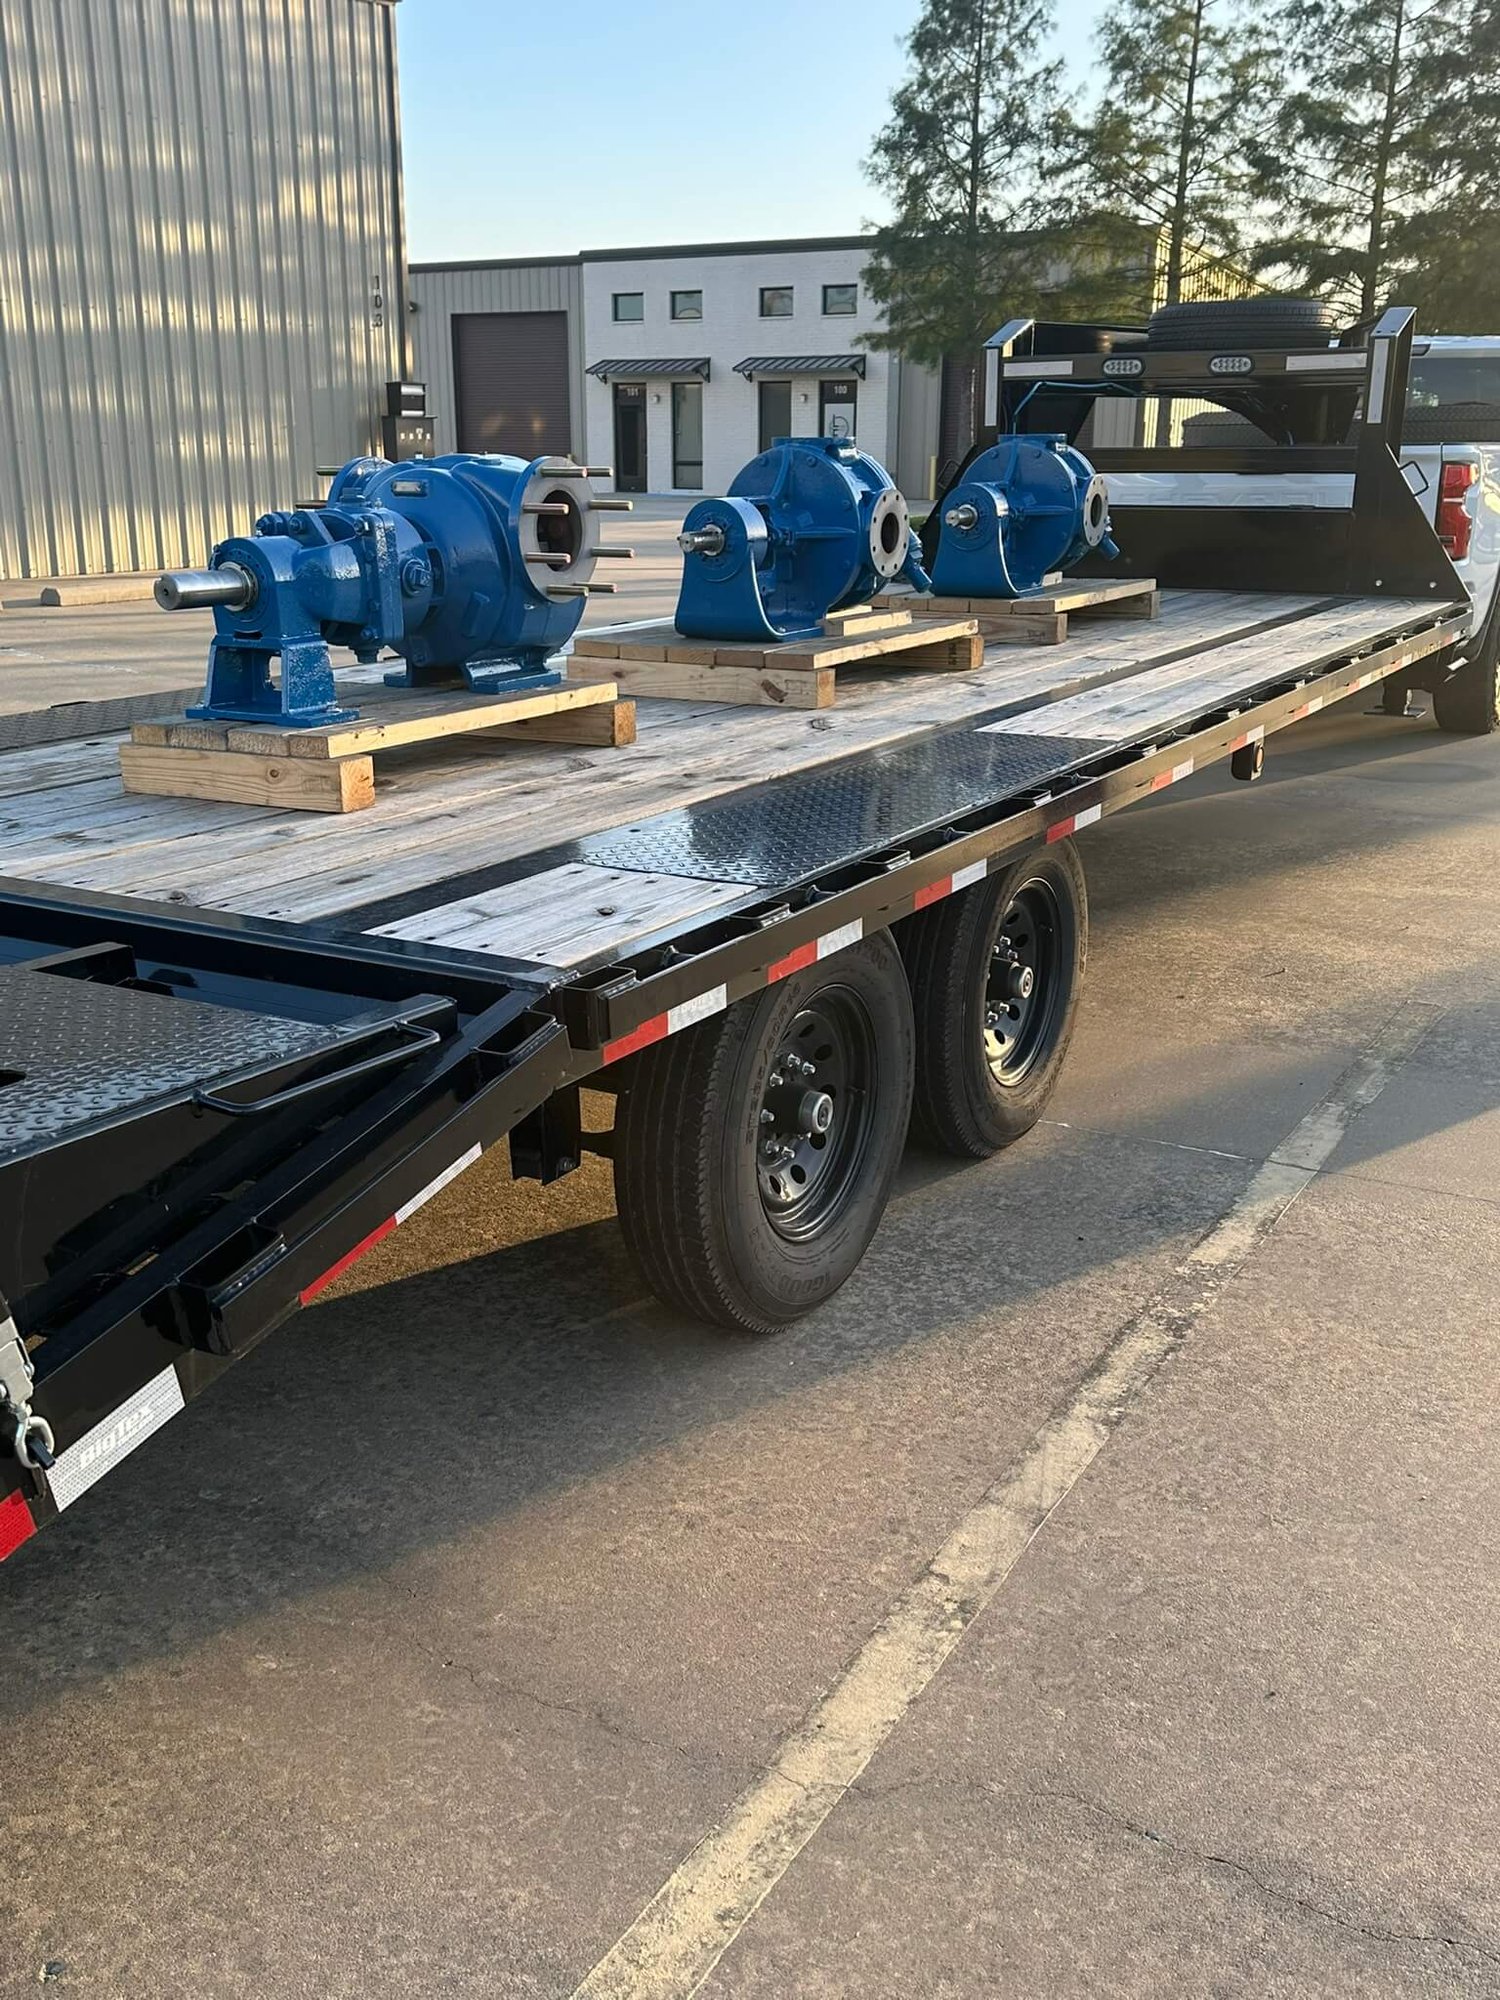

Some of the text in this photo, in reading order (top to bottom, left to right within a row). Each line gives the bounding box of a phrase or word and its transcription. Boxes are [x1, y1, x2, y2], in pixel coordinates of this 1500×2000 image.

[834, 385, 848, 394] 100
[80, 1429, 117, 1469] Big
[115, 1402, 154, 1440] Tex
